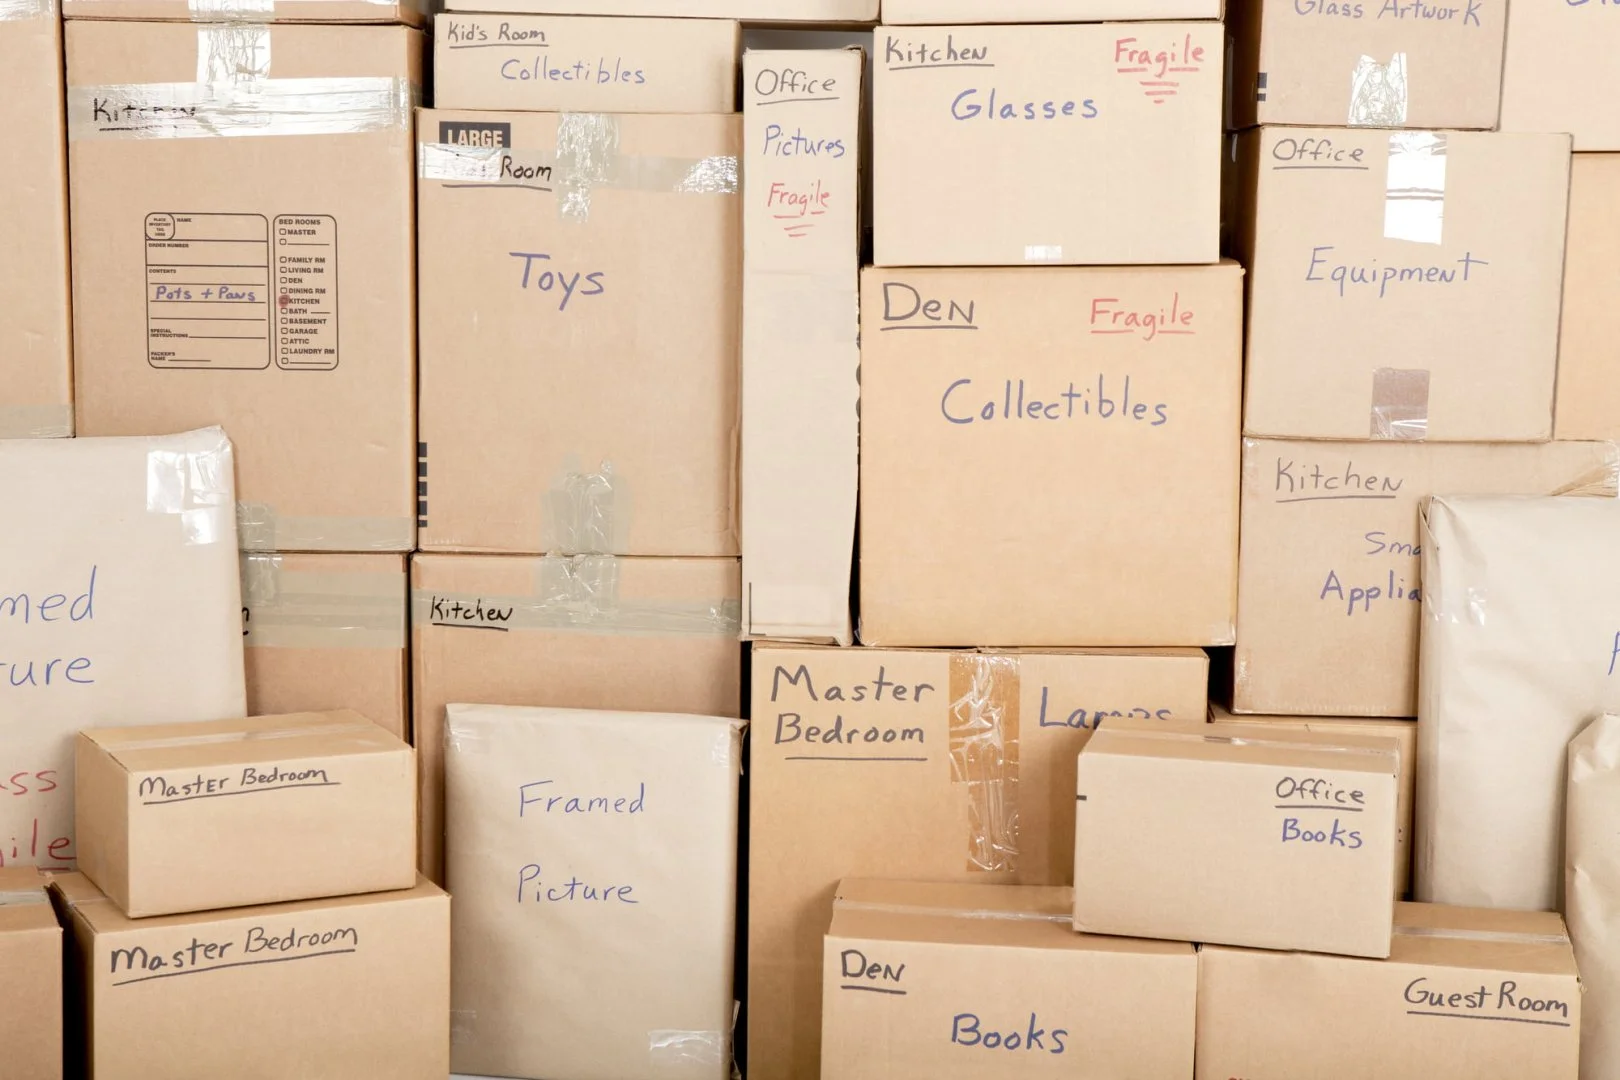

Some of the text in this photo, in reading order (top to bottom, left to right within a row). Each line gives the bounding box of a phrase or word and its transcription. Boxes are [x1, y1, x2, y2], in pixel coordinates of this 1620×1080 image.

[447, 21, 546, 42] Kid's Room
[501, 56, 646, 84] Collectibles
[1114, 34, 1205, 78] Fragile
[755, 68, 837, 96] Office
[951, 88, 1099, 121] Glasses
[447, 129, 504, 148] LARGE
[764, 124, 846, 158] Pictures
[1272, 138, 1364, 163] Office
[500, 155, 552, 182] Room
[767, 180, 831, 216] Fragile
[155, 285, 193, 300] Pots
[509, 252, 605, 311] Toys
[1090, 292, 1195, 341] Fragile
[941, 374, 1168, 426] Collectibles
[0, 657, 95, 687] ure
[770, 665, 937, 704] Master
[774, 712, 925, 746] Bedroom
[0, 769, 57, 795] ss
[241, 766, 329, 786] Bedroom
[1275, 777, 1366, 805] Office
[518, 780, 645, 818] Framed
[0, 818, 77, 868] ile
[1282, 818, 1364, 850] Books
[517, 863, 640, 904] Picture
[110, 925, 358, 974] Master Bedroom
[1403, 977, 1569, 1018] Guest Room
[950, 1012, 1070, 1055] Books
